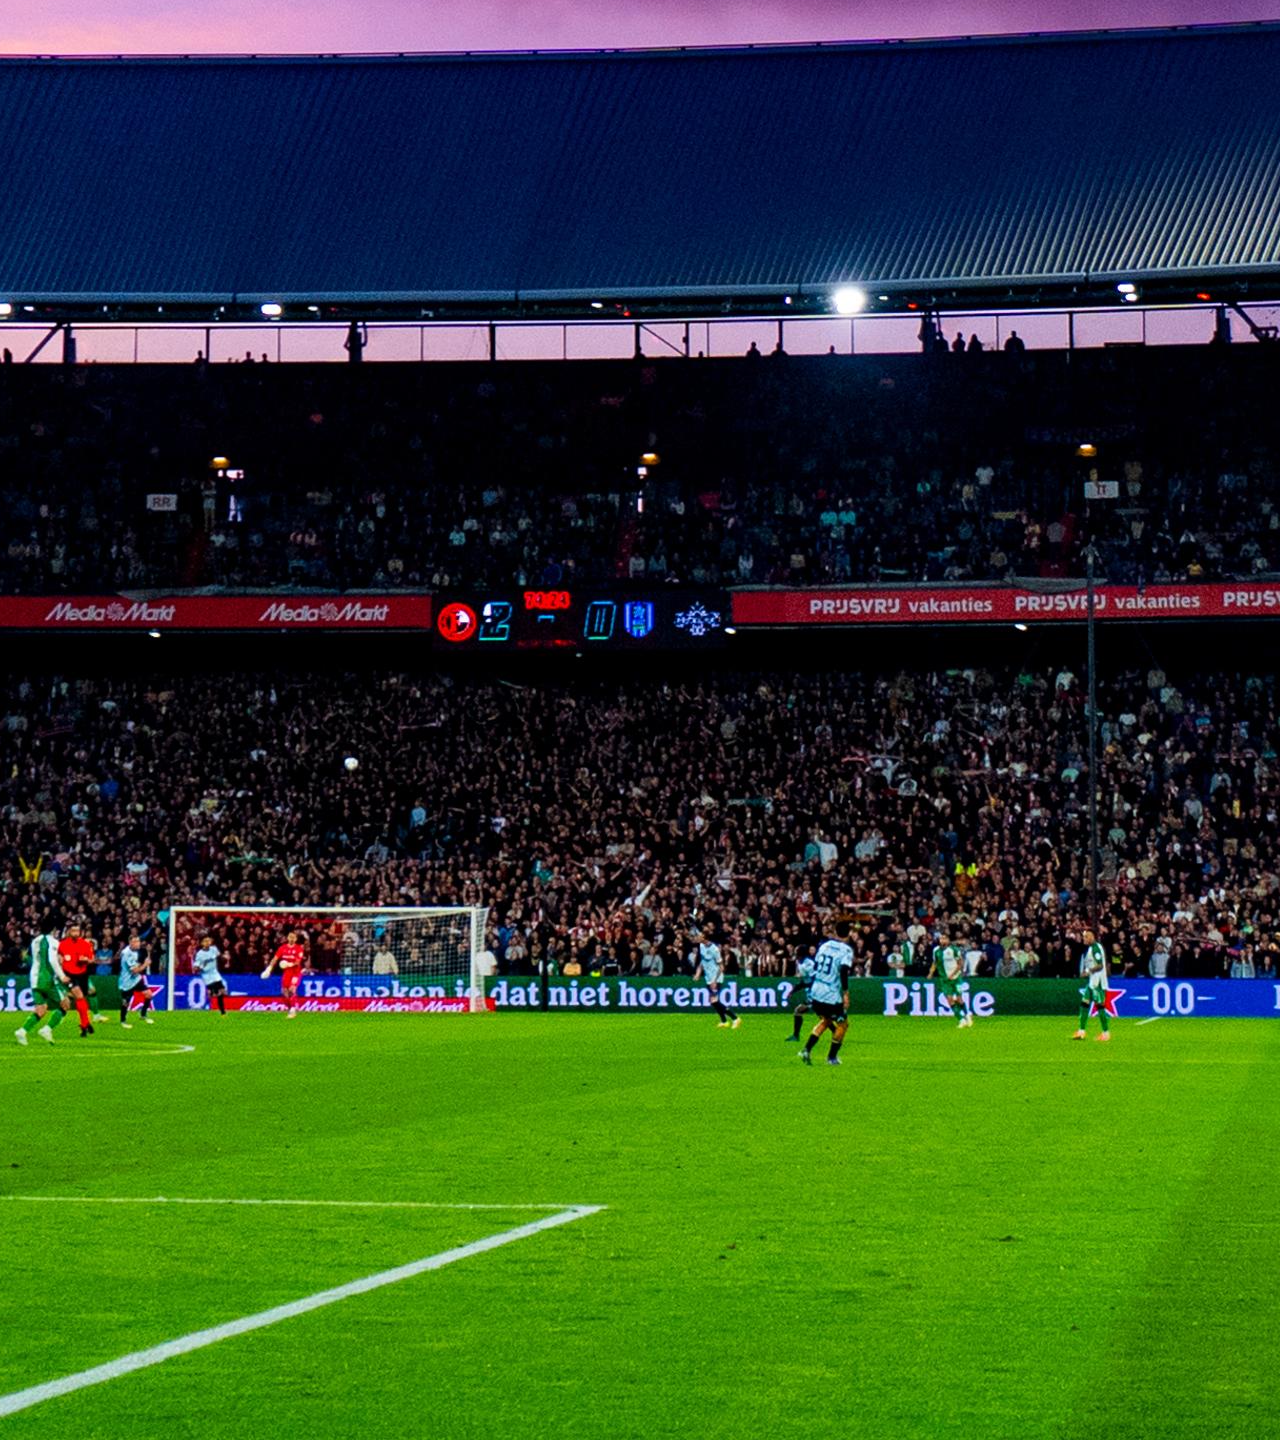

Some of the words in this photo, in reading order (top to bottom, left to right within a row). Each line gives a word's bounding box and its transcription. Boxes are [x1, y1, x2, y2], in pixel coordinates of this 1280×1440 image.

[908, 597, 993, 614] vakanties
[1114, 592, 1201, 610] vakanties
[816, 953, 834, 975] 33
[490, 980, 540, 1006] dat
[547, 980, 610, 1006] niet
[617, 980, 713, 1007] horen
[719, 981, 795, 1008] dan?
[882, 981, 996, 1017] Pilsie
